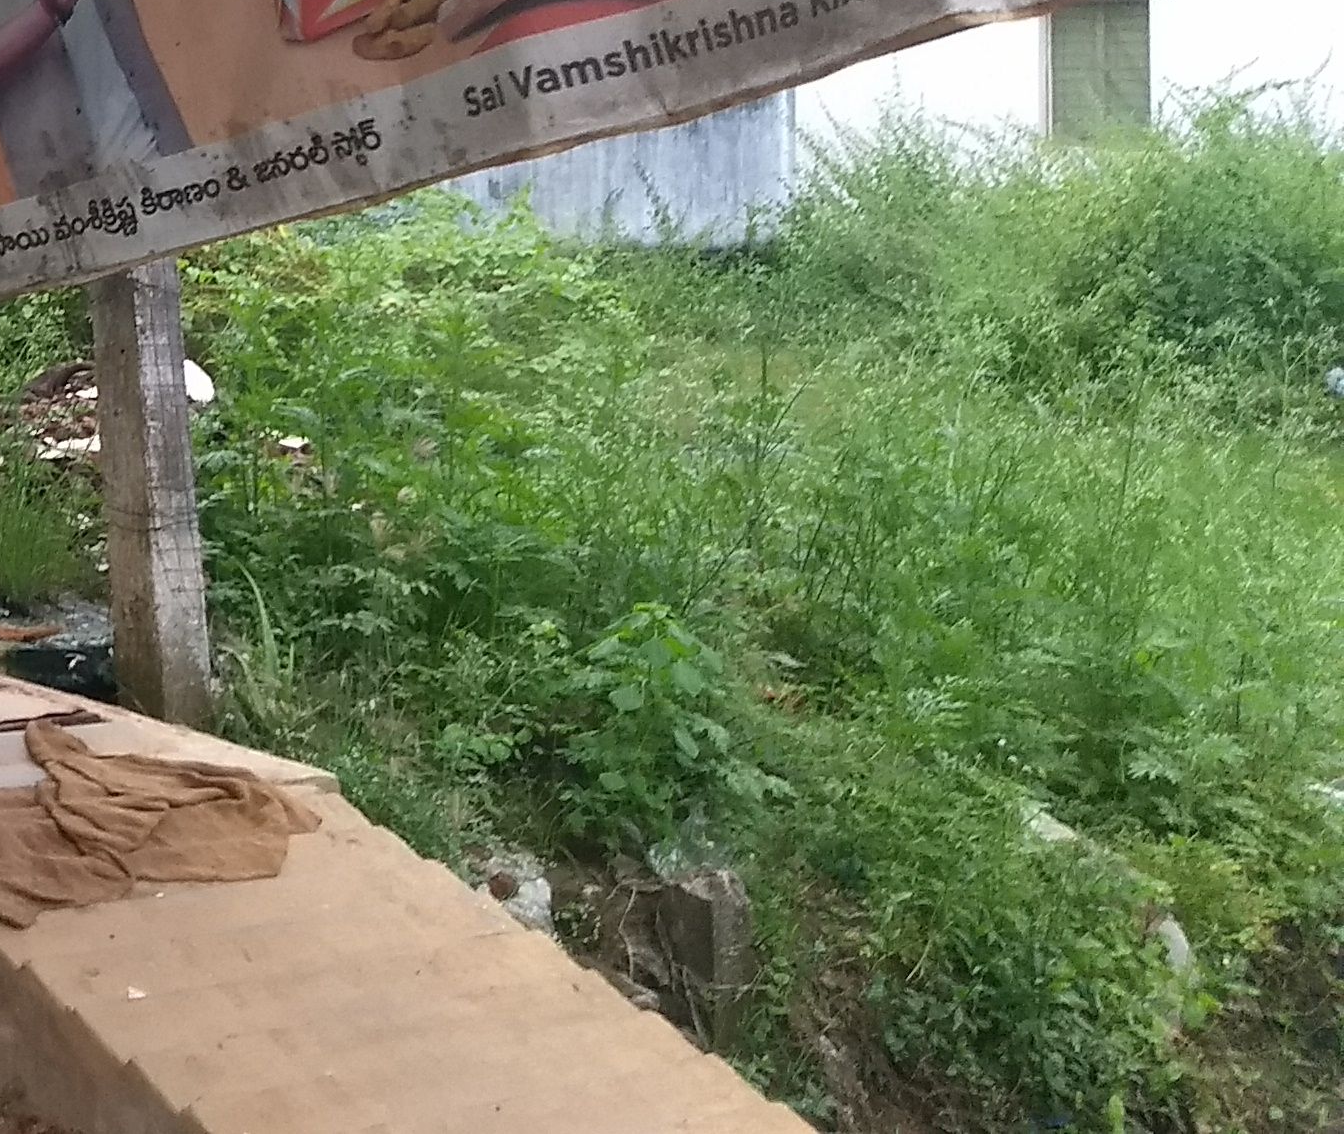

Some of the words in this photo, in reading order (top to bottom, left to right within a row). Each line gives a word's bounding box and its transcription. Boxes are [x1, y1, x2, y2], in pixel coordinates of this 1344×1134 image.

[463, 74, 507, 118] Sai
[509, 0, 799, 100] Vamshikrishna
[225, 166, 252, 192] &
